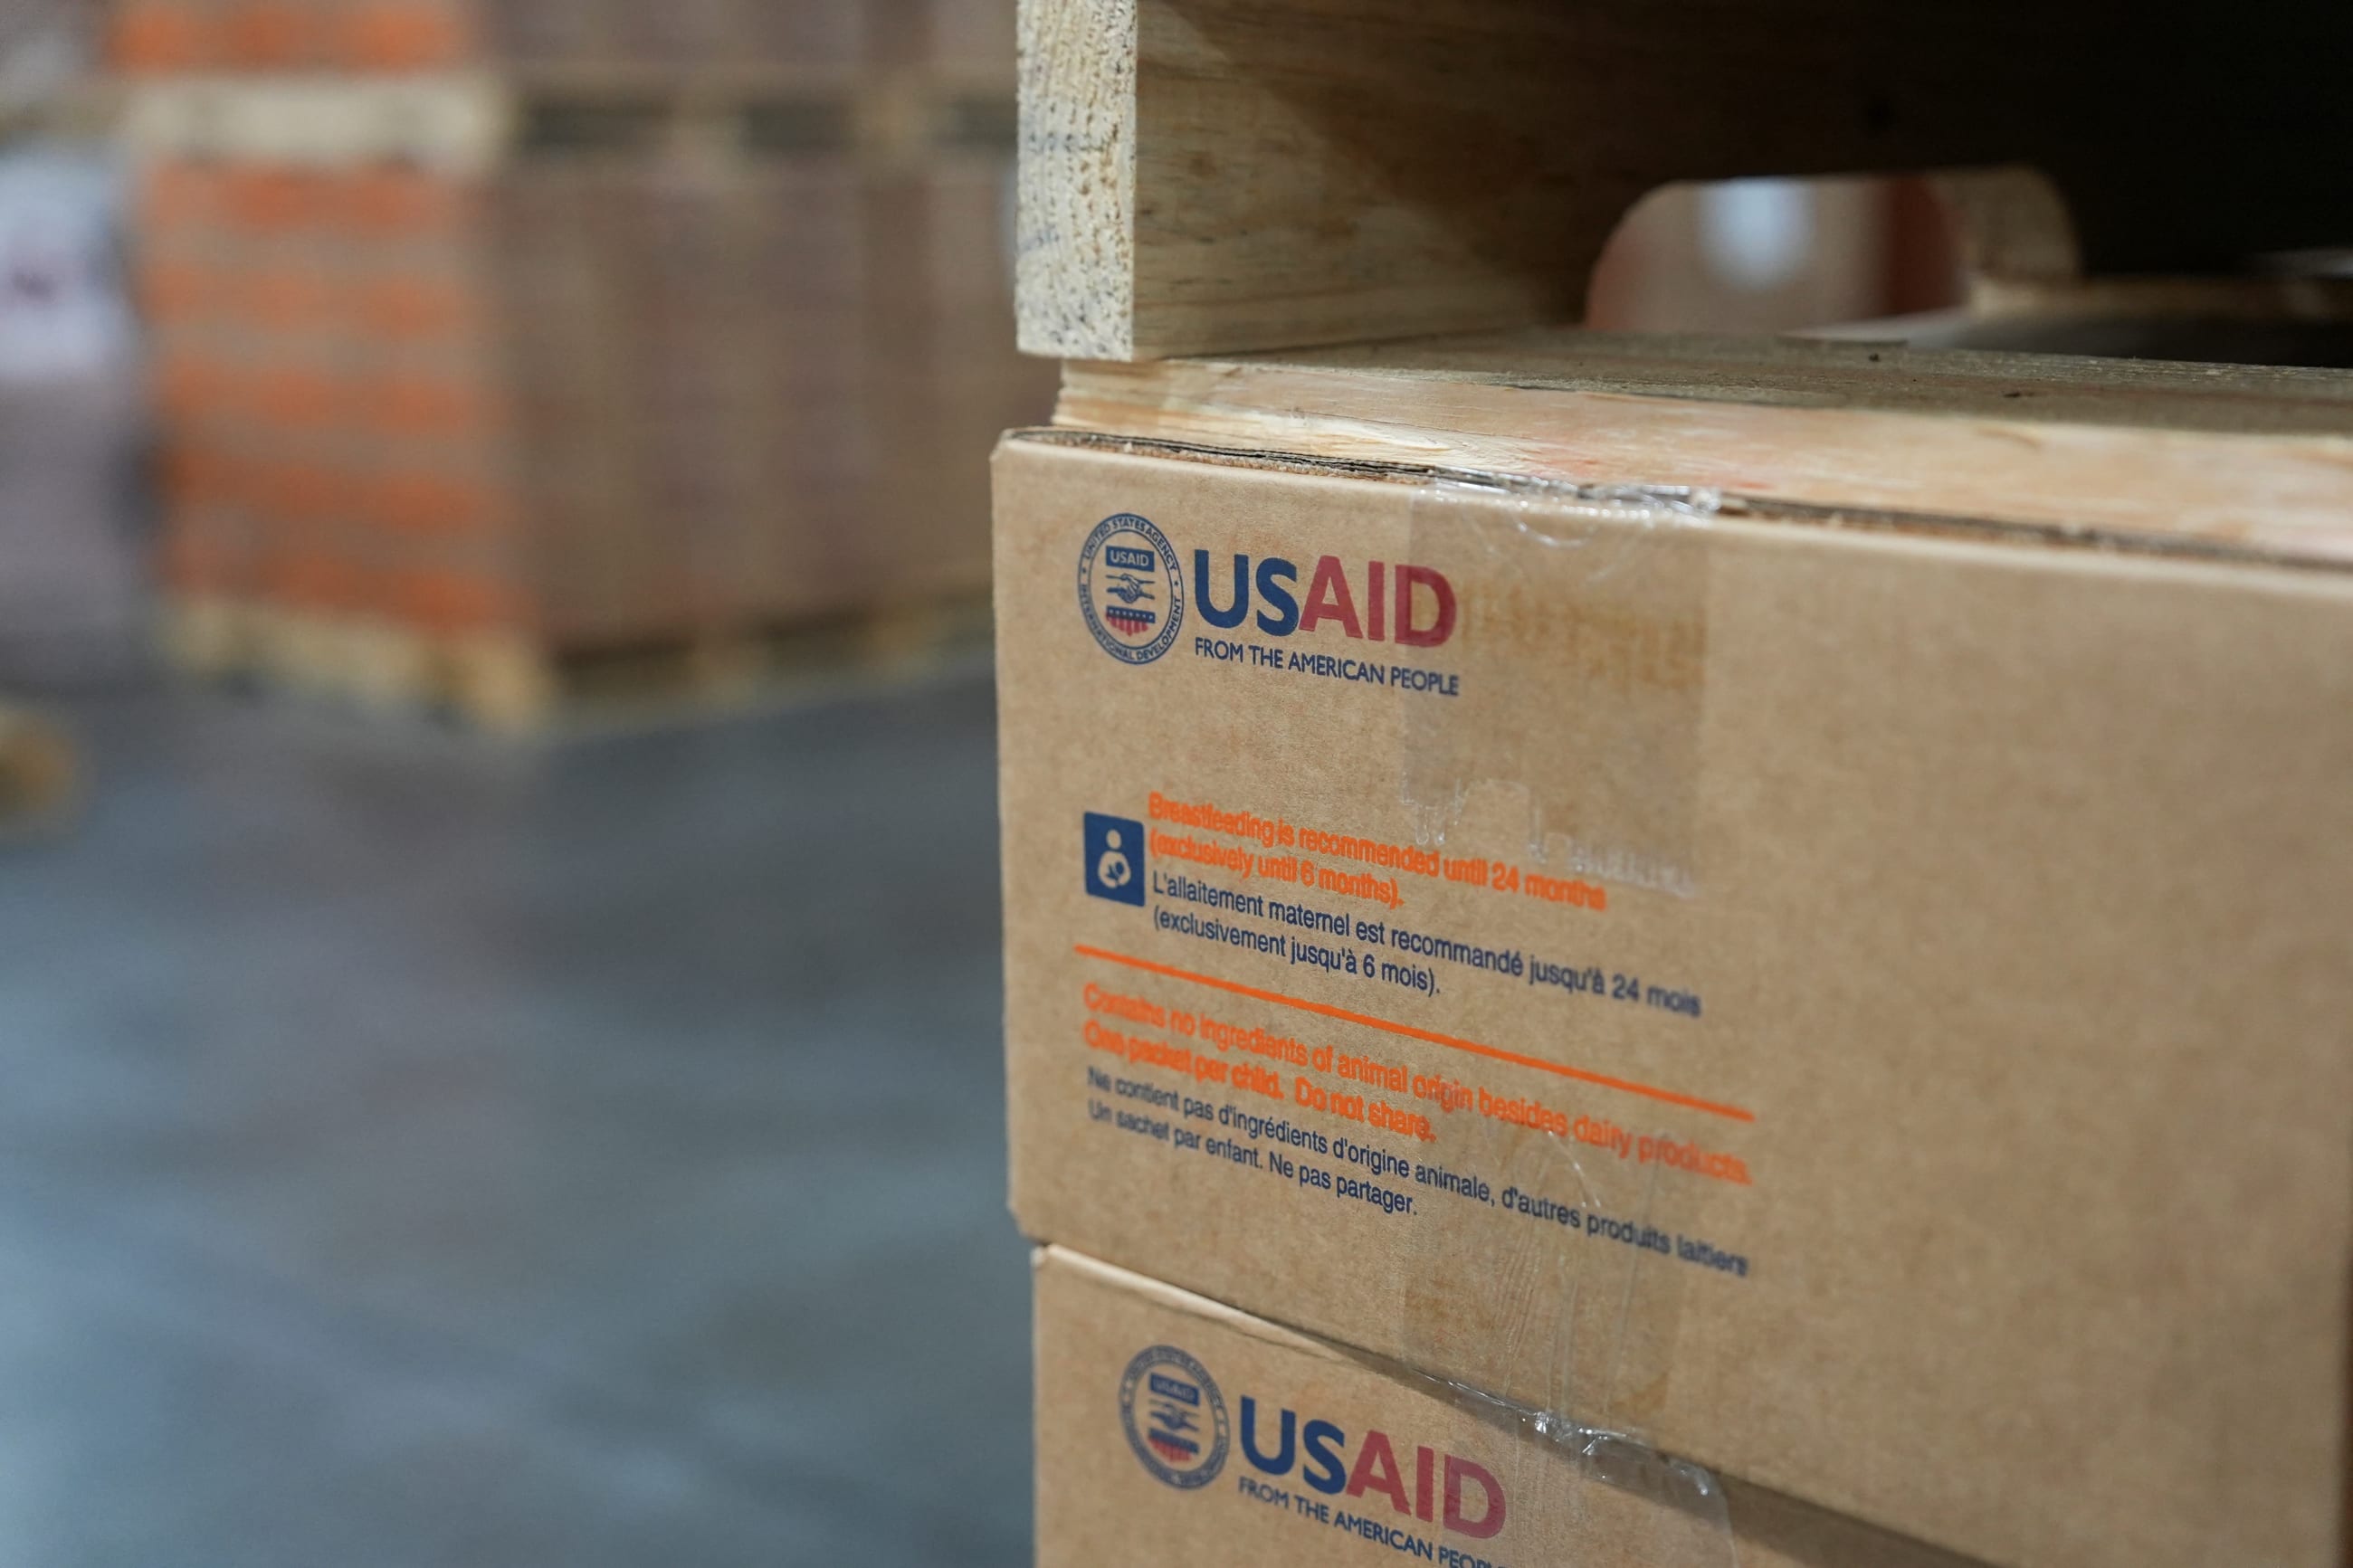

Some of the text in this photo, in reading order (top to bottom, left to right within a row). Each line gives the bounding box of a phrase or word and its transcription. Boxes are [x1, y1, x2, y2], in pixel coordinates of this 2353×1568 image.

[1110, 549, 1149, 567] USAID
[1112, 516, 1146, 533] STATES
[1146, 523, 1177, 570] AGENCY
[1136, 596, 1182, 661] DEVELOPMENT
[1195, 548, 1456, 648] USAID
[1195, 637, 1460, 697] FROM THE AMERICAN PEOPLE
[1148, 790, 1607, 913] Breastfeeding is recommended until 24 months
[1149, 827, 1405, 910] (exclusively until 6 months).
[1153, 870, 1702, 1020] L'allaitement maternel est recommandé jusqu'à 24 mois
[1154, 905, 1441, 997] (exclusivement jusqu'à 6 mois).
[1083, 1018, 1437, 1144] One packet per child. Do not share.
[1170, 1008, 1197, 1037] no
[1200, 1012, 1309, 1067] ingredients
[1311, 1044, 1333, 1073] of
[1337, 1053, 1408, 1094] animal
[1412, 1073, 1474, 1114] origin
[1479, 1087, 1568, 1138] besides
[1573, 1115, 1634, 1159] dairy
[1638, 1134, 1754, 1188] products.
[1087, 1065, 1748, 1278] Ne contient pas d'ingrédients d'origine animale, d'autres produits laitiers
[1088, 1098, 1417, 1216] Un sachet par enfant. Ne pas partager.
[1240, 1394, 1507, 1539] USAID
[1238, 1475, 1291, 1511] FROM
[1293, 1493, 1330, 1525] THE
[1334, 1509, 1434, 1562] AMERICAN
